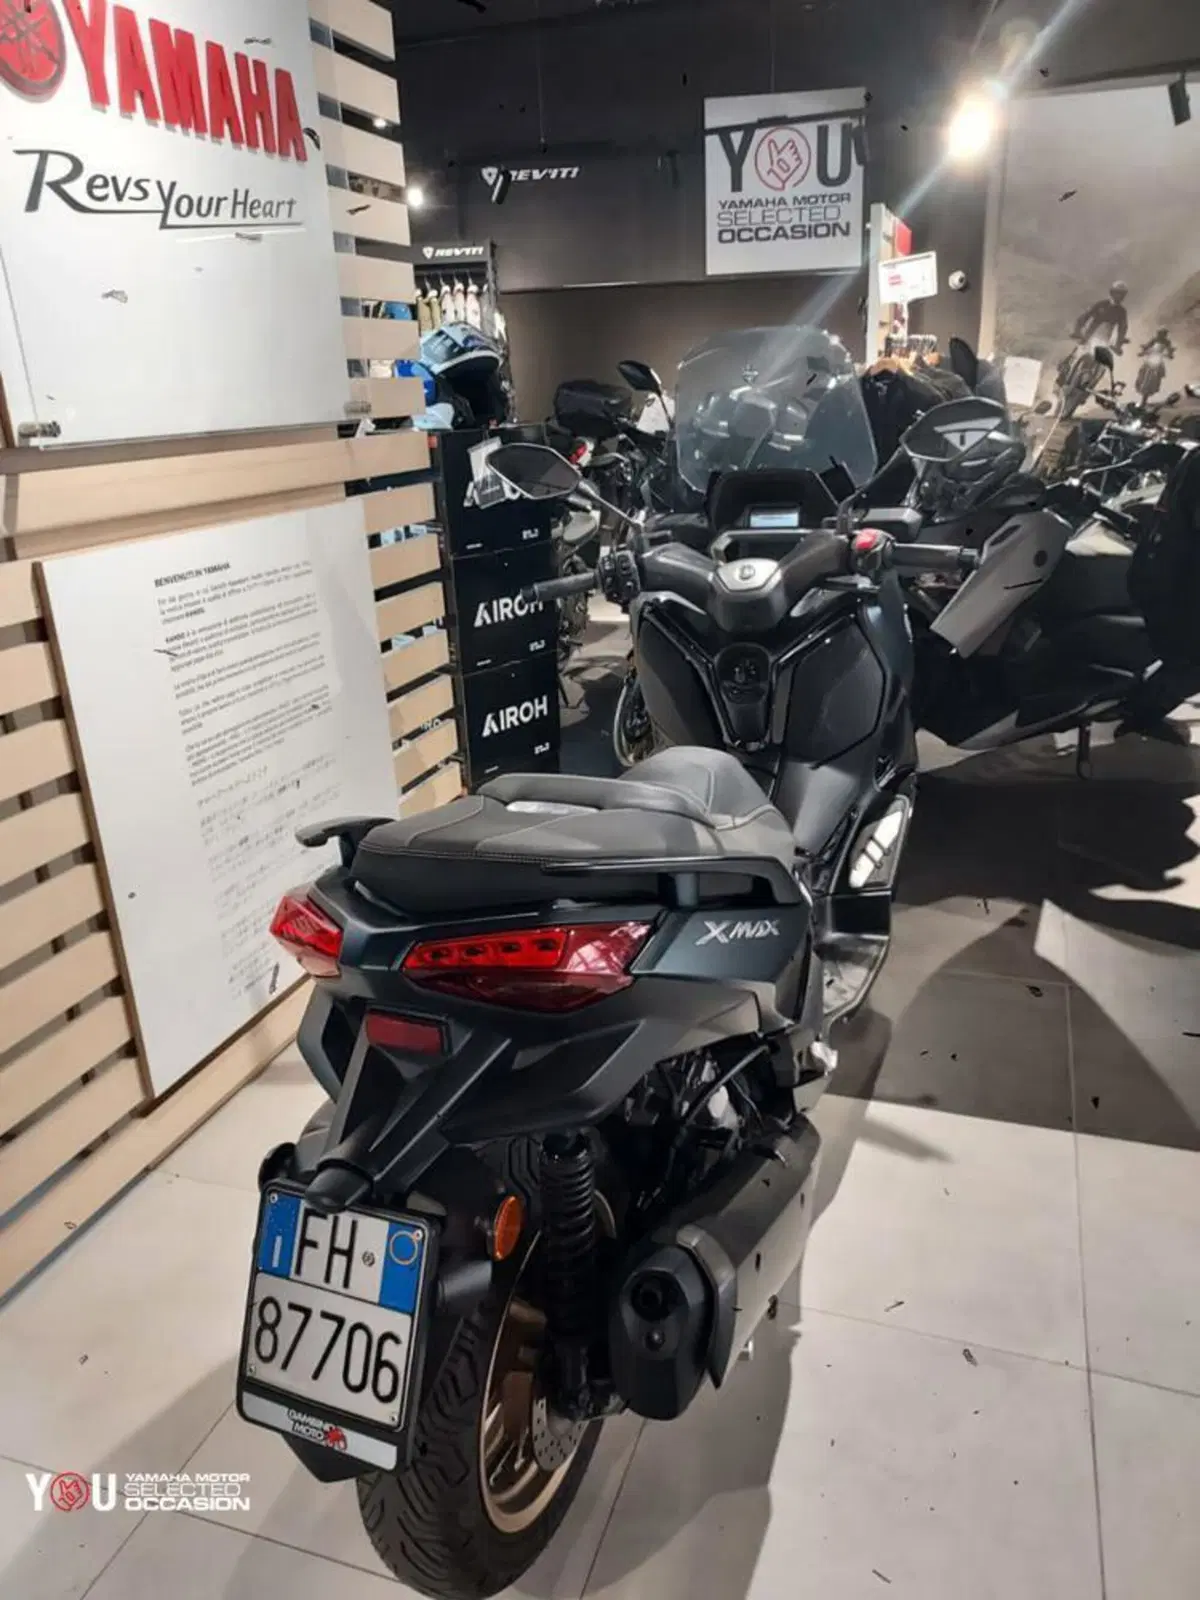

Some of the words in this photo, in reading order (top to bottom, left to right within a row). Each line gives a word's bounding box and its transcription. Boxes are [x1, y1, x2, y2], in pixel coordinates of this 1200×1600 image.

[62, 0, 307, 162] YAMAHA
[13, 149, 152, 213] Revs
[157, 180, 229, 229] Your
[231, 189, 298, 220] Heart
[717, 205, 841, 228] SELECTED
[718, 196, 788, 210] YAMAHA
[793, 192, 851, 207] MOTOR
[718, 222, 851, 245] OCCASION
[482, 694, 548, 737] AIROH
[294, 1207, 358, 1290] FH
[254, 1295, 403, 1405] 87706
